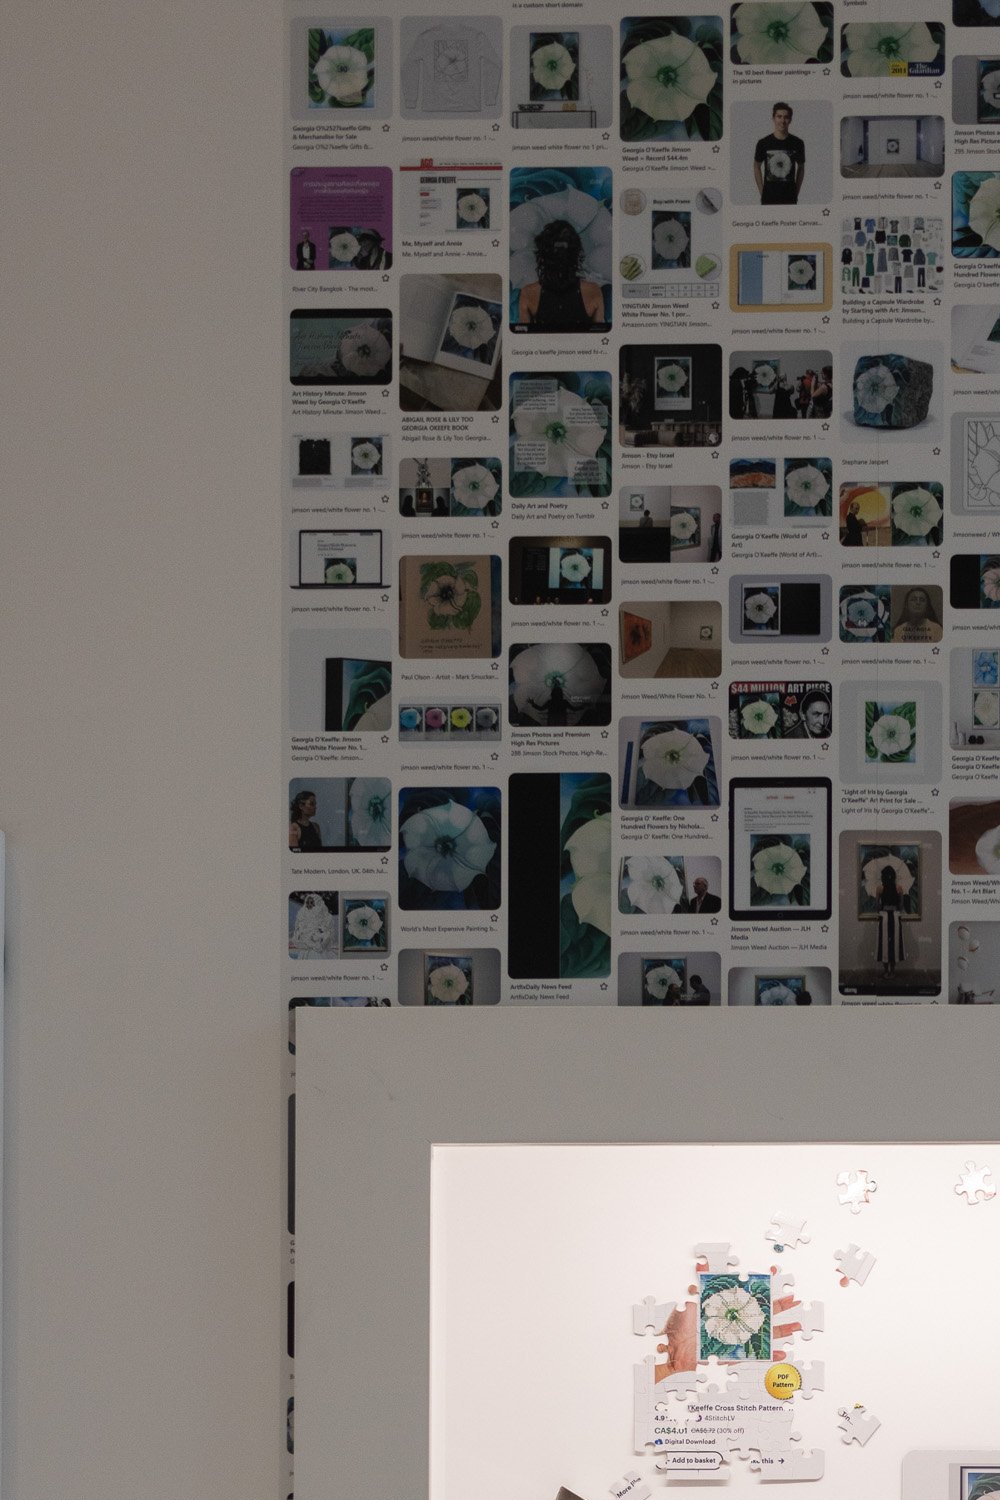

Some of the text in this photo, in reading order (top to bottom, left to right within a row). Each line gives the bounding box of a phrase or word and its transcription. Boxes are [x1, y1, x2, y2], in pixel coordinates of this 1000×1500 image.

[731, 683, 748, 693] $44
[750, 683, 785, 693] MILLION
[787, 683, 804, 693] ART
[616, 1484, 632, 1498] More
